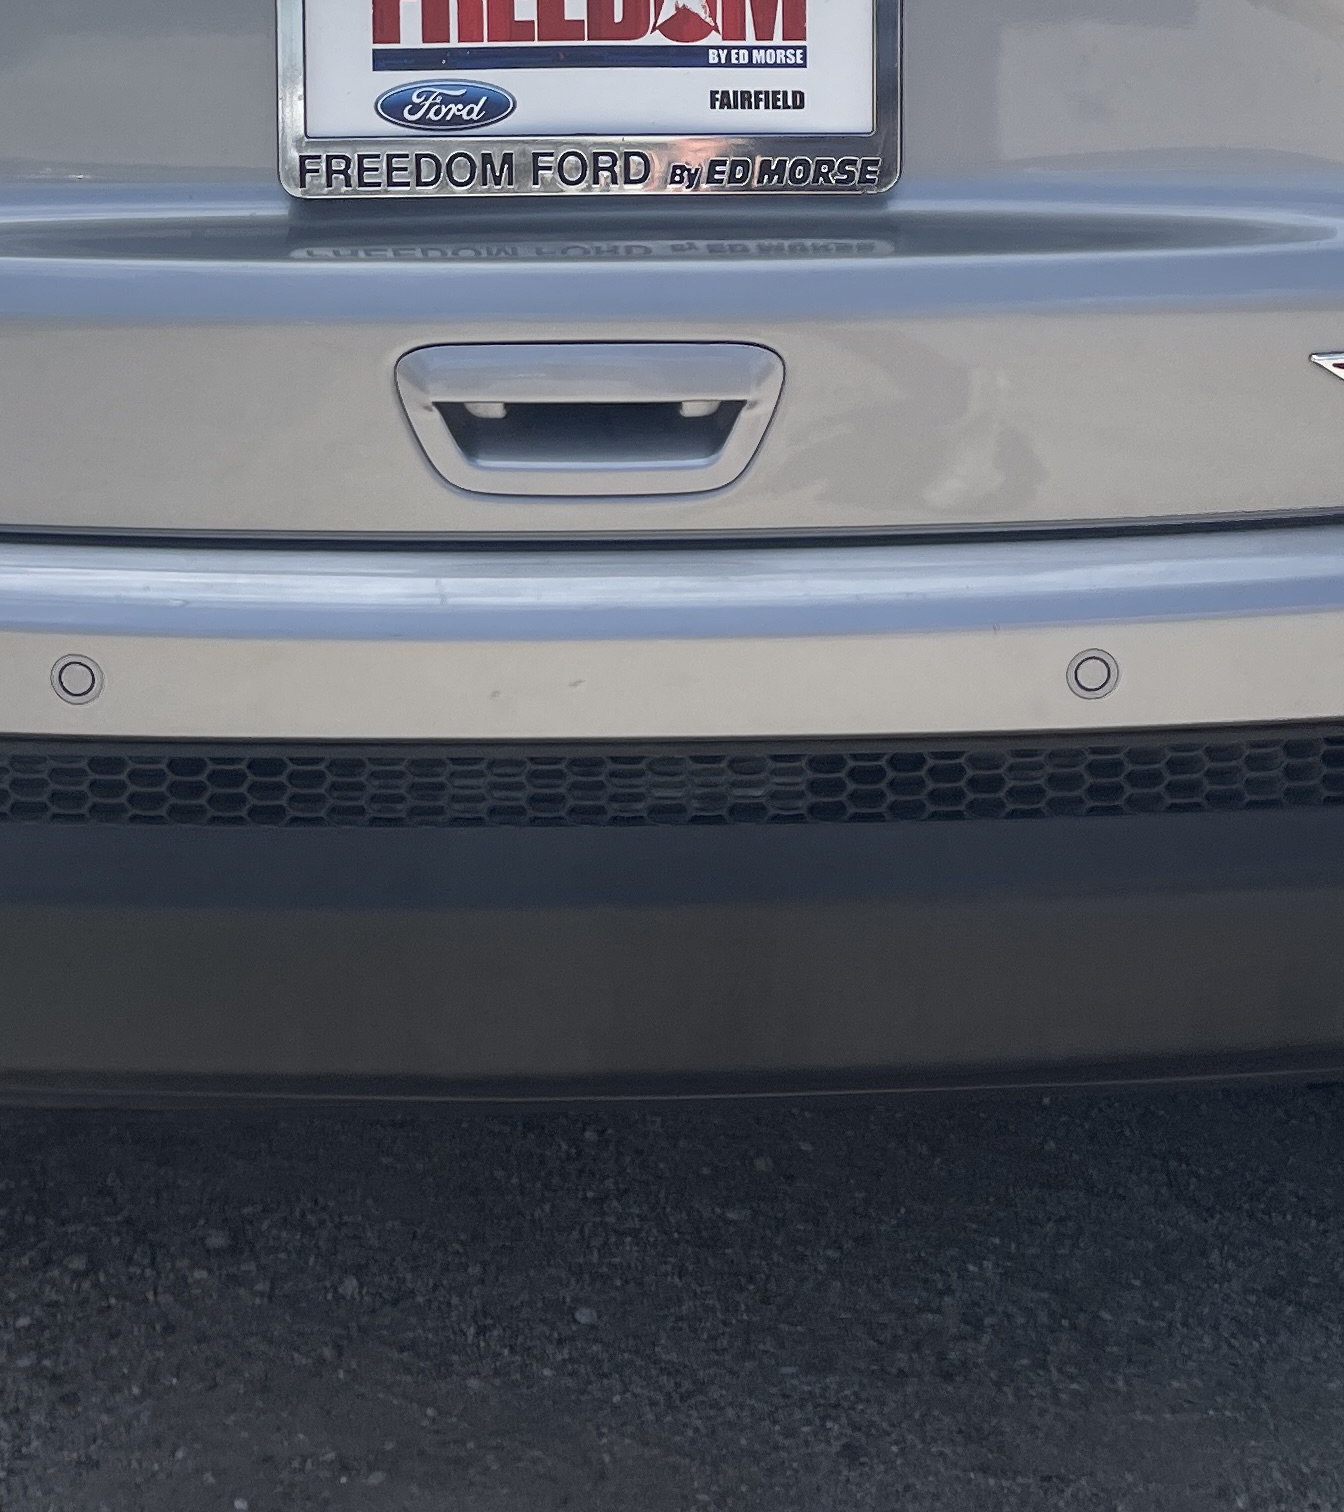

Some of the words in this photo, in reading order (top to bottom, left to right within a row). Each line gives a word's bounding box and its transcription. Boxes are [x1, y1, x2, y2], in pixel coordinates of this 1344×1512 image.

[708, 49, 728, 66] BY
[730, 49, 749, 66] ED
[751, 48, 804, 66] MORSE
[403, 80, 486, 124] Ford
[709, 89, 805, 111] FAIRFIELD
[298, 151, 515, 190] FREEDOM
[531, 150, 650, 188] FORD
[669, 162, 701, 190] By
[706, 157, 751, 186] ED
[756, 157, 881, 186] MORSE
